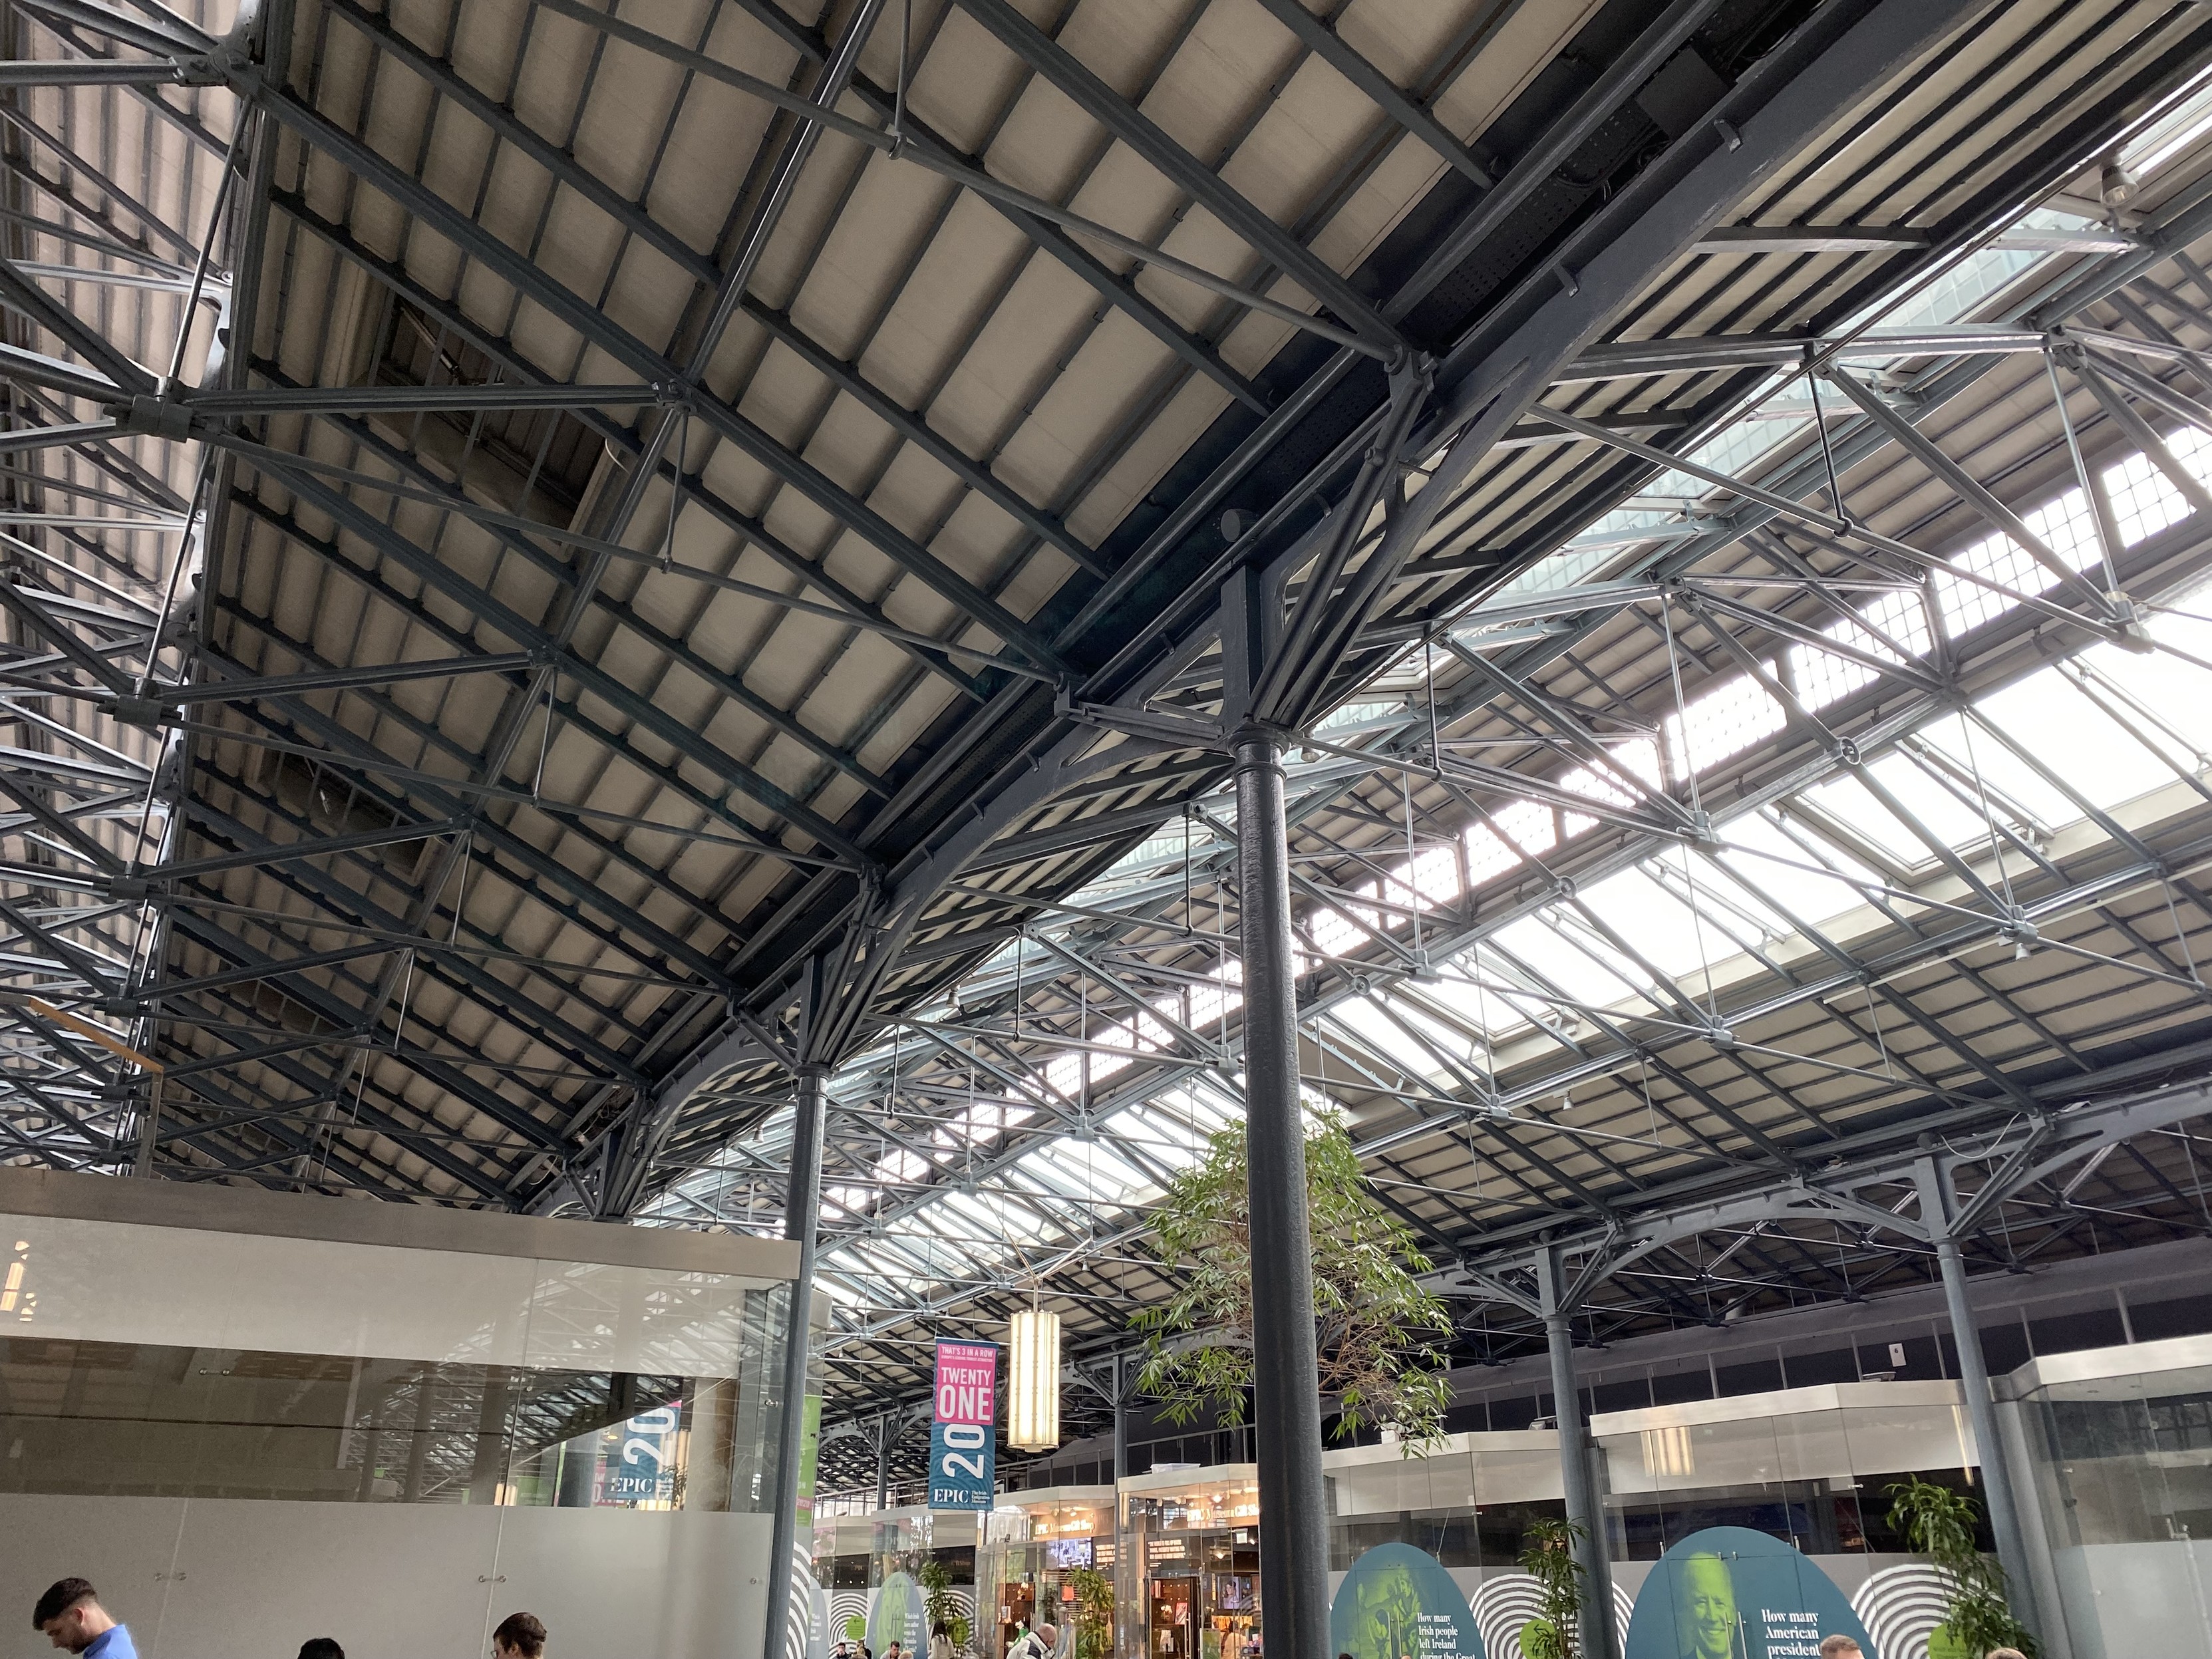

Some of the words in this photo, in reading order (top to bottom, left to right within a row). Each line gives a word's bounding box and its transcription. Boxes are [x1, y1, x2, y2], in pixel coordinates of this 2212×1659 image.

[941, 1346, 960, 1355] THAT'S
[941, 1366, 991, 1386] TWENTY
[939, 1384, 991, 1421] ONE
[942, 1424, 985, 1479] 20
[609, 1477, 653, 1493] EPIC
[934, 1489, 969, 1503] EPIC
[1206, 1508, 1235, 1520] Museum
[1417, 1612, 1432, 1622] How
[1434, 1615, 1451, 1625] many
[1761, 1609, 1786, 1622] How
[1789, 1612, 1819, 1626] many
[1418, 1625, 1434, 1636] Irish
[1435, 1625, 1458, 1639] people
[1766, 1626, 1819, 1640] American
[1419, 1638, 1430, 1649] left
[1432, 1638, 1457, 1649] Ireland
[1767, 1642, 1821, 1659] president
